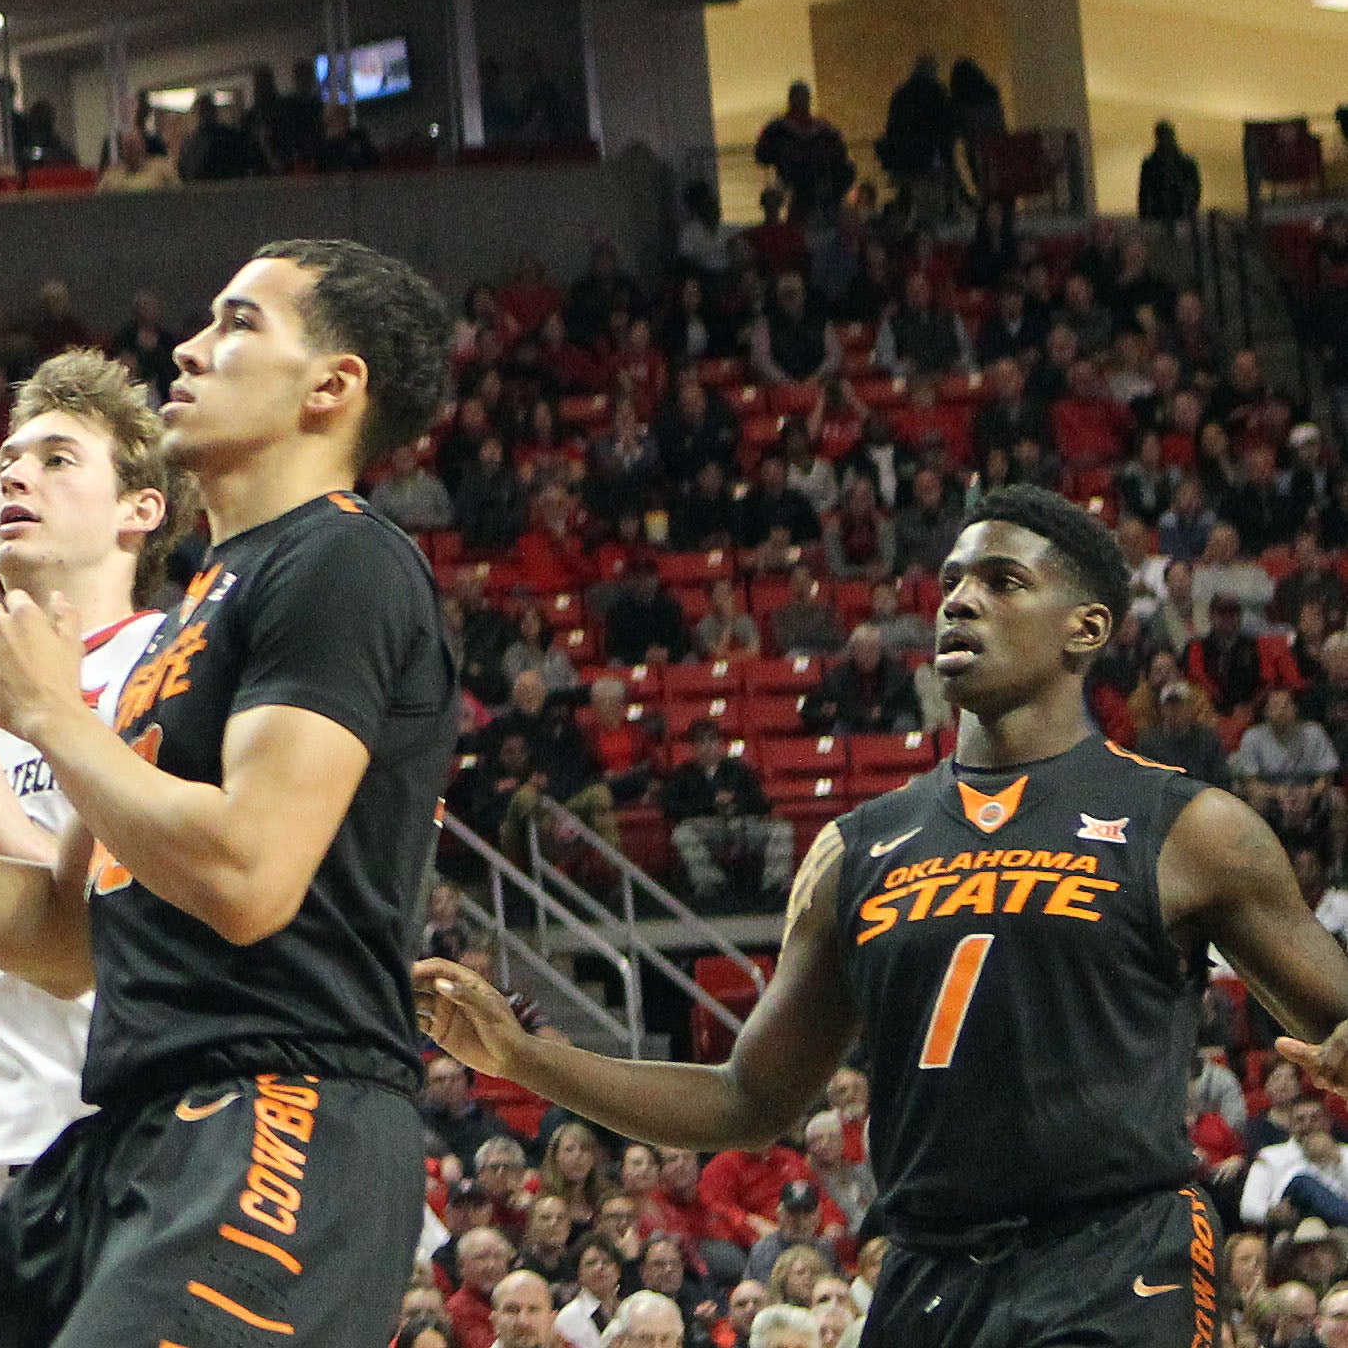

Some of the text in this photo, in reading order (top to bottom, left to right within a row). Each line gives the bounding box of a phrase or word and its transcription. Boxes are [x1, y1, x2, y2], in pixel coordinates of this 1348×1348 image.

[856, 870, 1121, 946] STATE
[884, 849, 1100, 890] OKLAHOMA
[918, 933, 995, 1070] 1
[239, 1073, 320, 1235] COWBO
